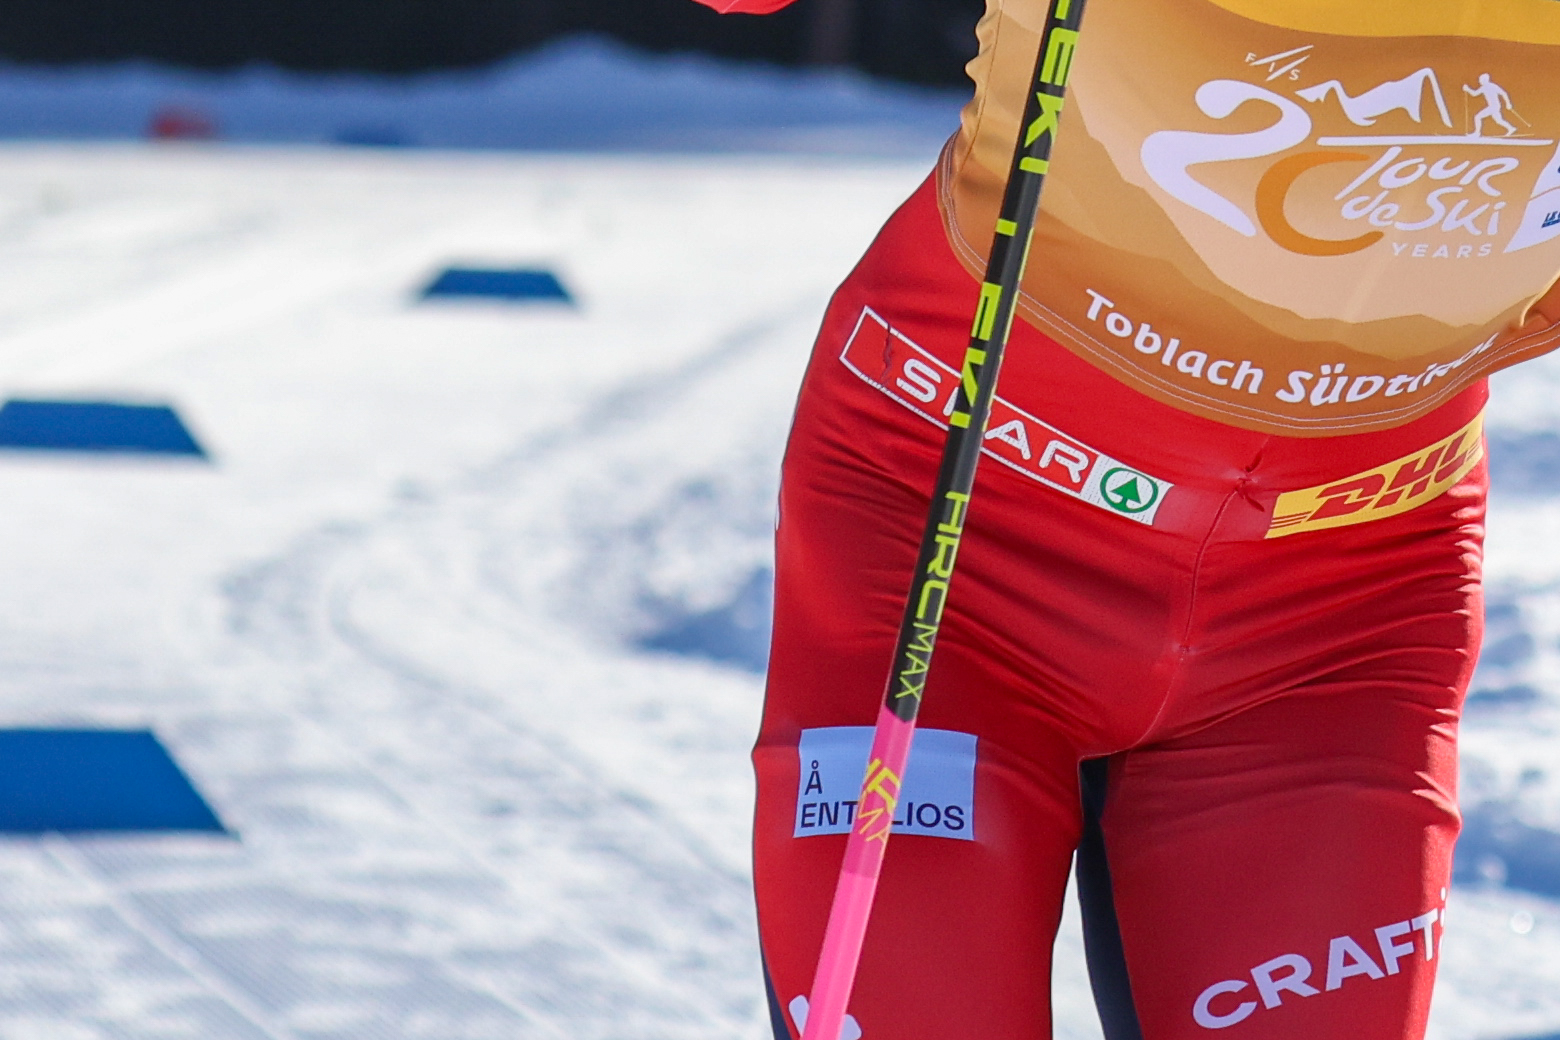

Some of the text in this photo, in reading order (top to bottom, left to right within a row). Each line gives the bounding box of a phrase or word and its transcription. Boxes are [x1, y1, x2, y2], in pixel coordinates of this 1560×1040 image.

[1391, 243, 1492, 259] YEARS
[1085, 288, 1264, 395] Toblach
[896, 357, 1090, 485] SAR
[1306, 430, 1469, 523] DHL
[800, 801, 965, 831] ENTIOS
[804, 759, 823, 796] Å
[1193, 908, 1439, 1029] CRAFT
